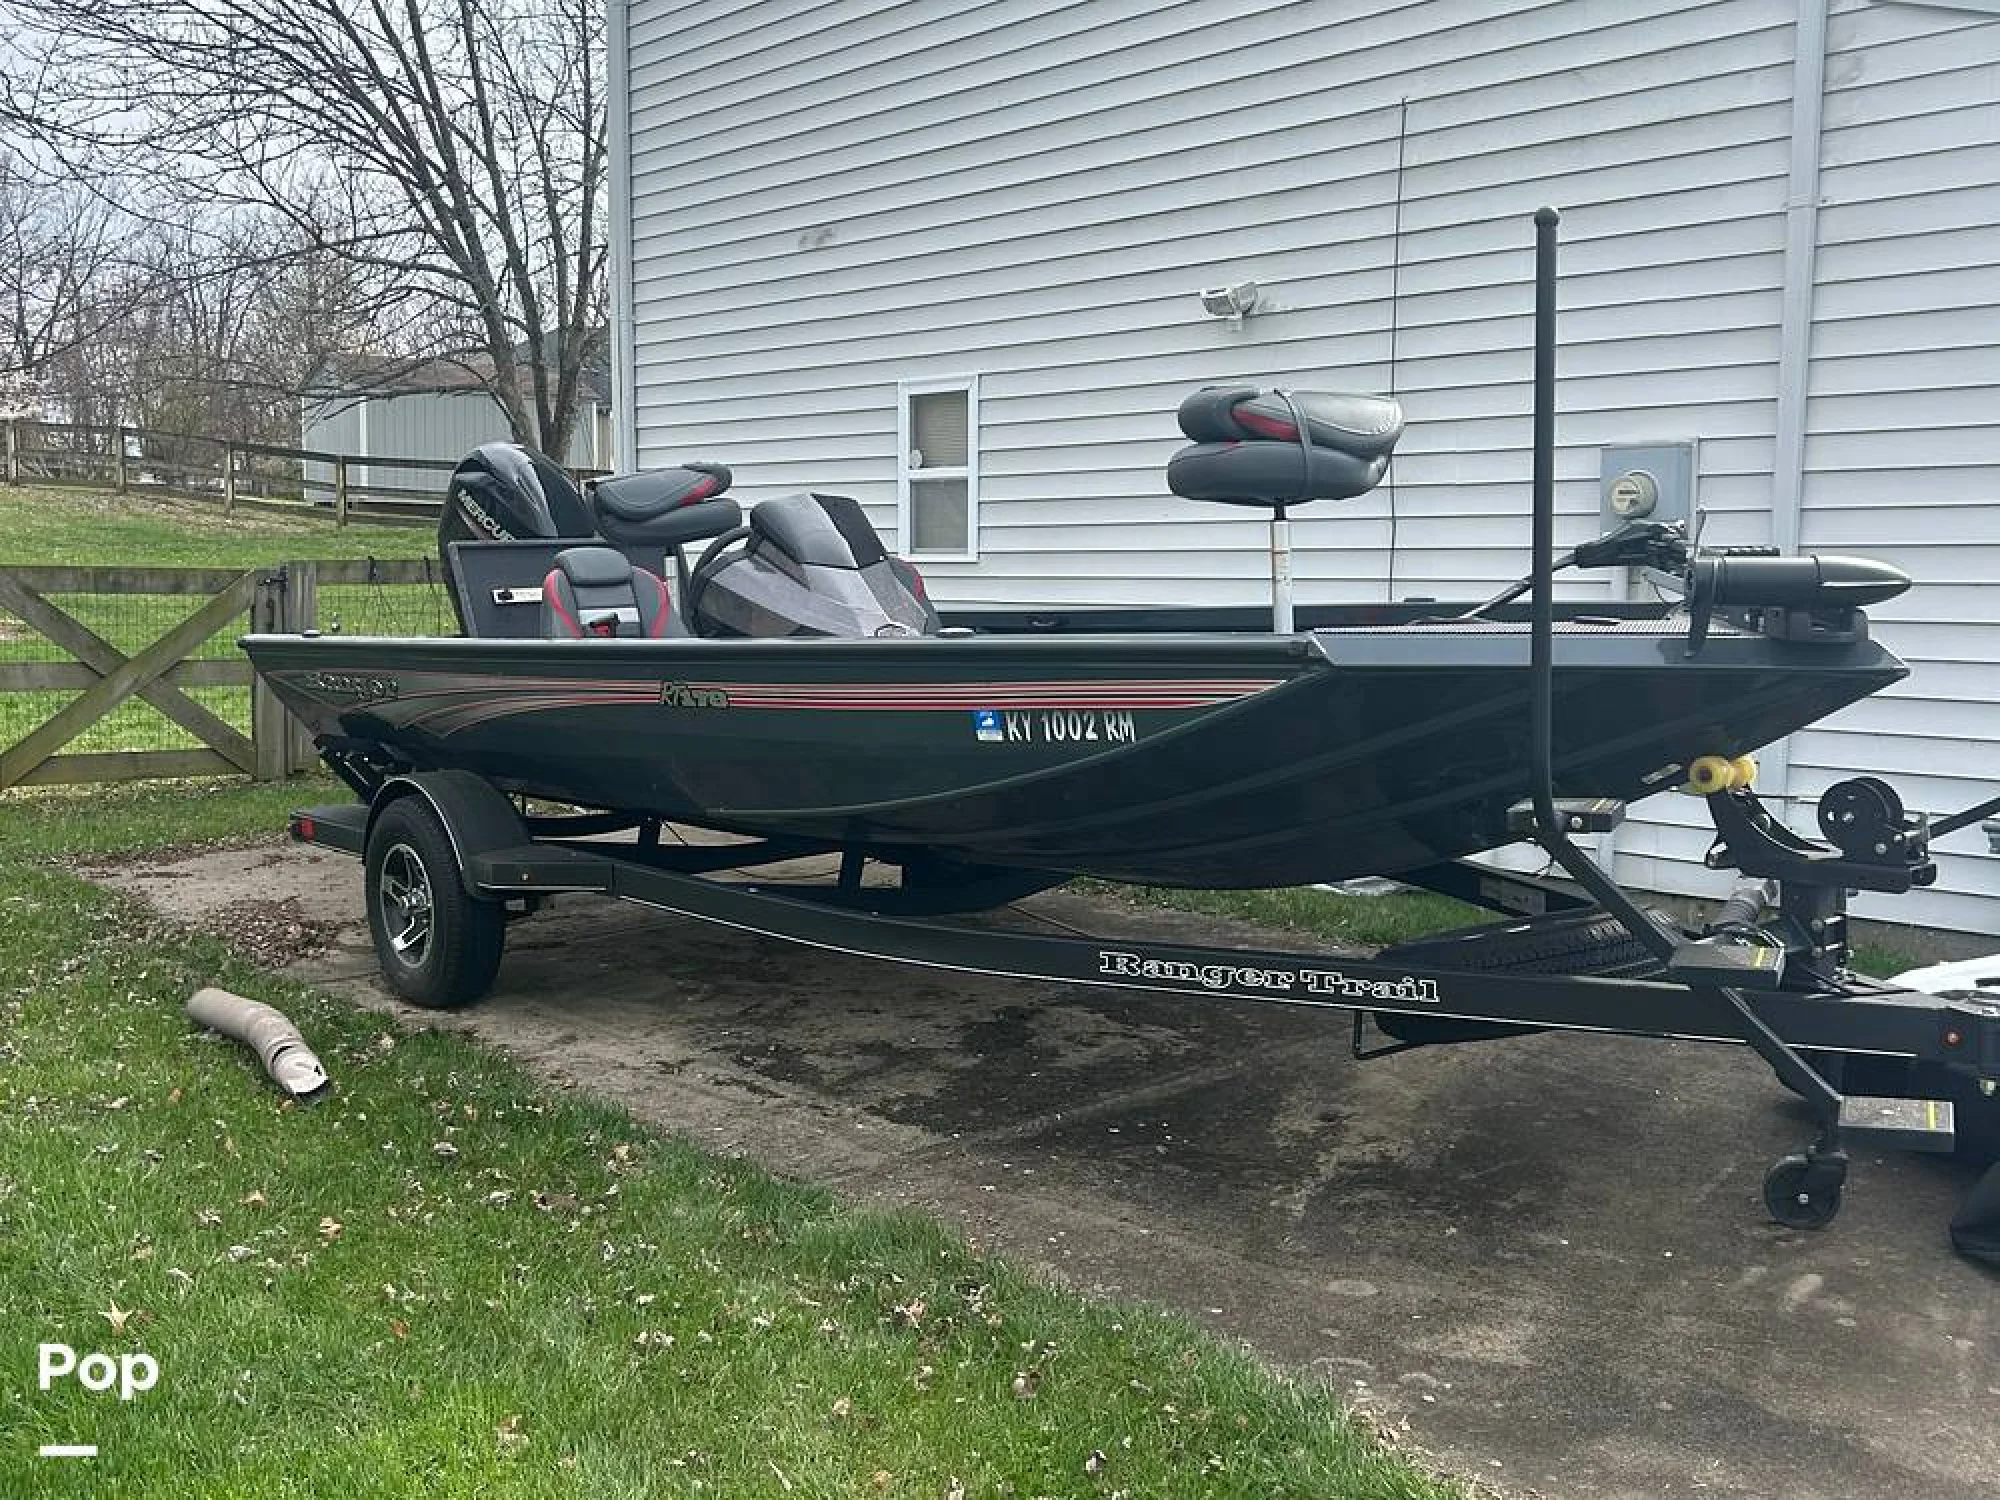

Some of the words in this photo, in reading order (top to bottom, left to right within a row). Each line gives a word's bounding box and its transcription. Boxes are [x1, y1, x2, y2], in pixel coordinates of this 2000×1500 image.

[1005, 711, 1031, 741] KY
[1041, 711, 1099, 741] 1002
[1103, 711, 1136, 742] RM
[1099, 951, 1295, 990] Ranger
[1299, 969, 1441, 1003] Trail
